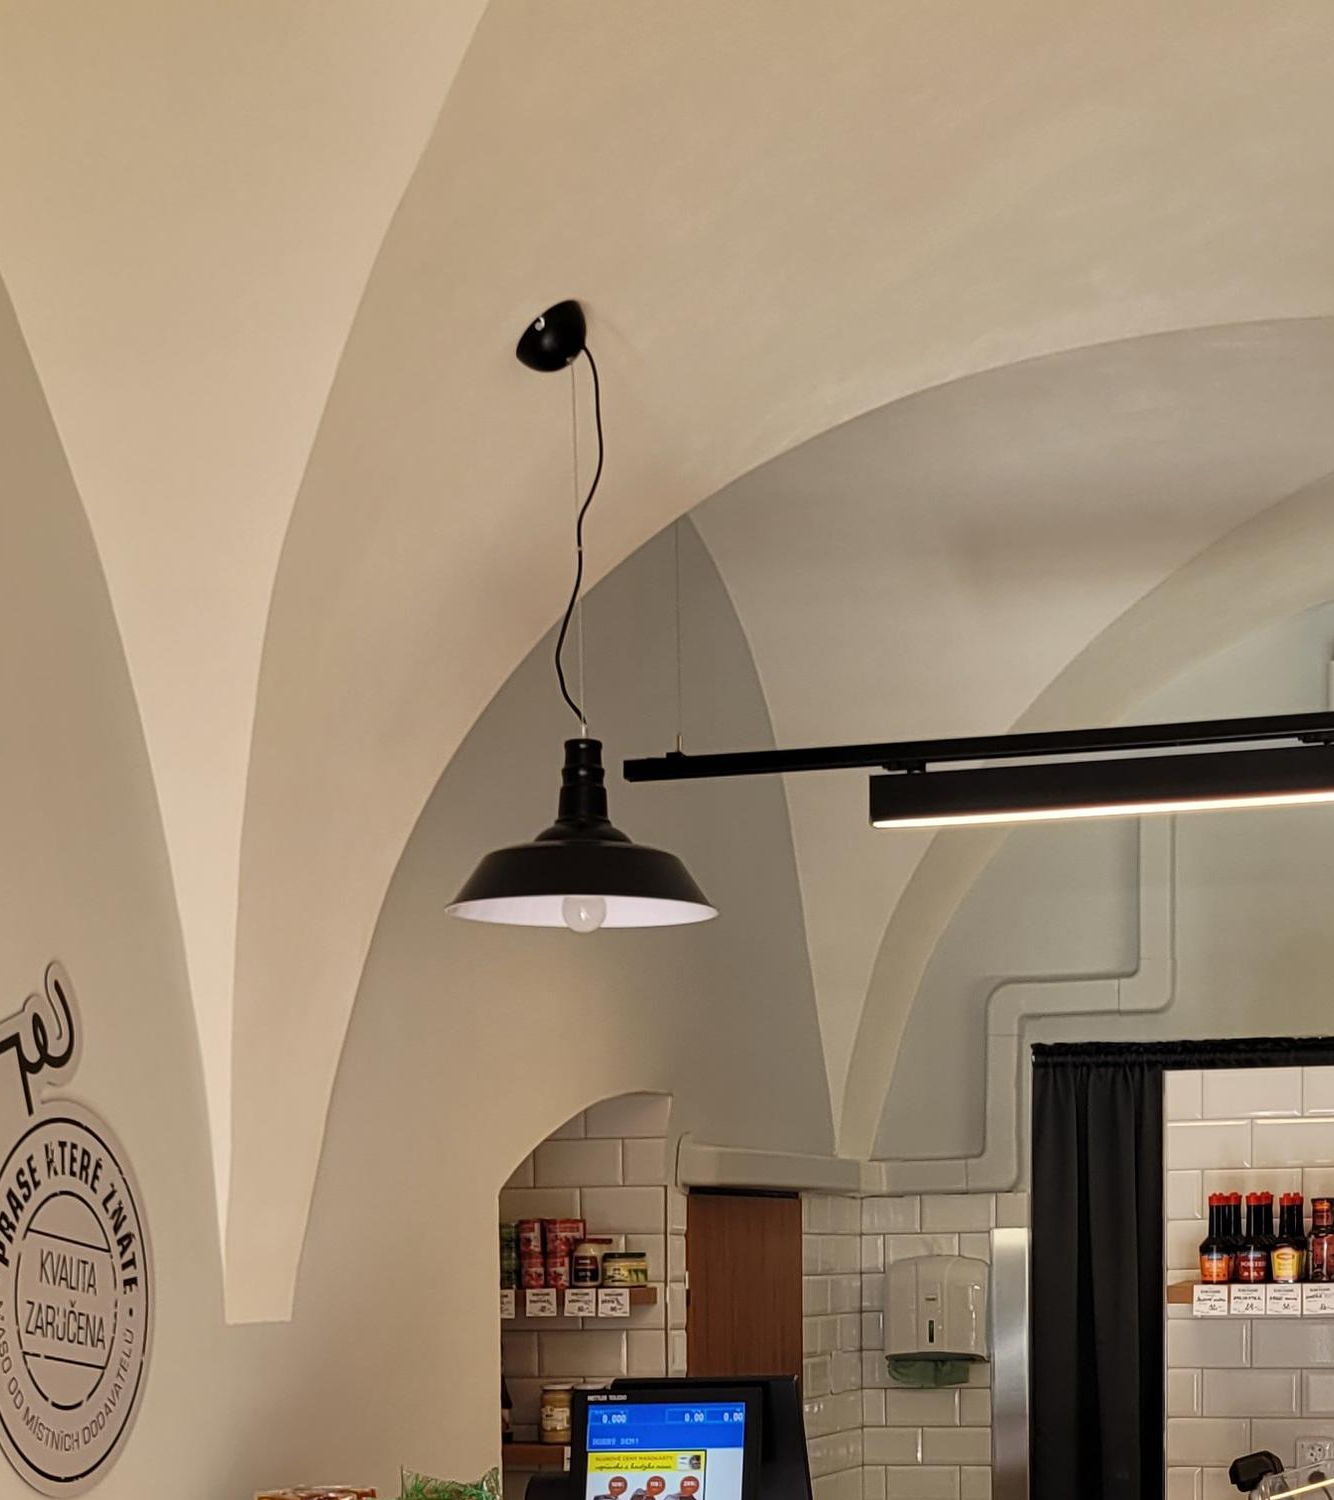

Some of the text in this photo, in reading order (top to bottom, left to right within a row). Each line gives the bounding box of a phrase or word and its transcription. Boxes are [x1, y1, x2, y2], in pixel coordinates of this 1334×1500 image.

[44, 1140, 103, 1195] KTERÉ
[103, 1182, 140, 1295] ZNÁTE
[39, 1248, 98, 1297] KVALITA
[25, 1299, 106, 1351] ZARUČENA
[7, 1376, 24, 1411] OD
[22, 1405, 80, 1453] MÍSTNÍCH
